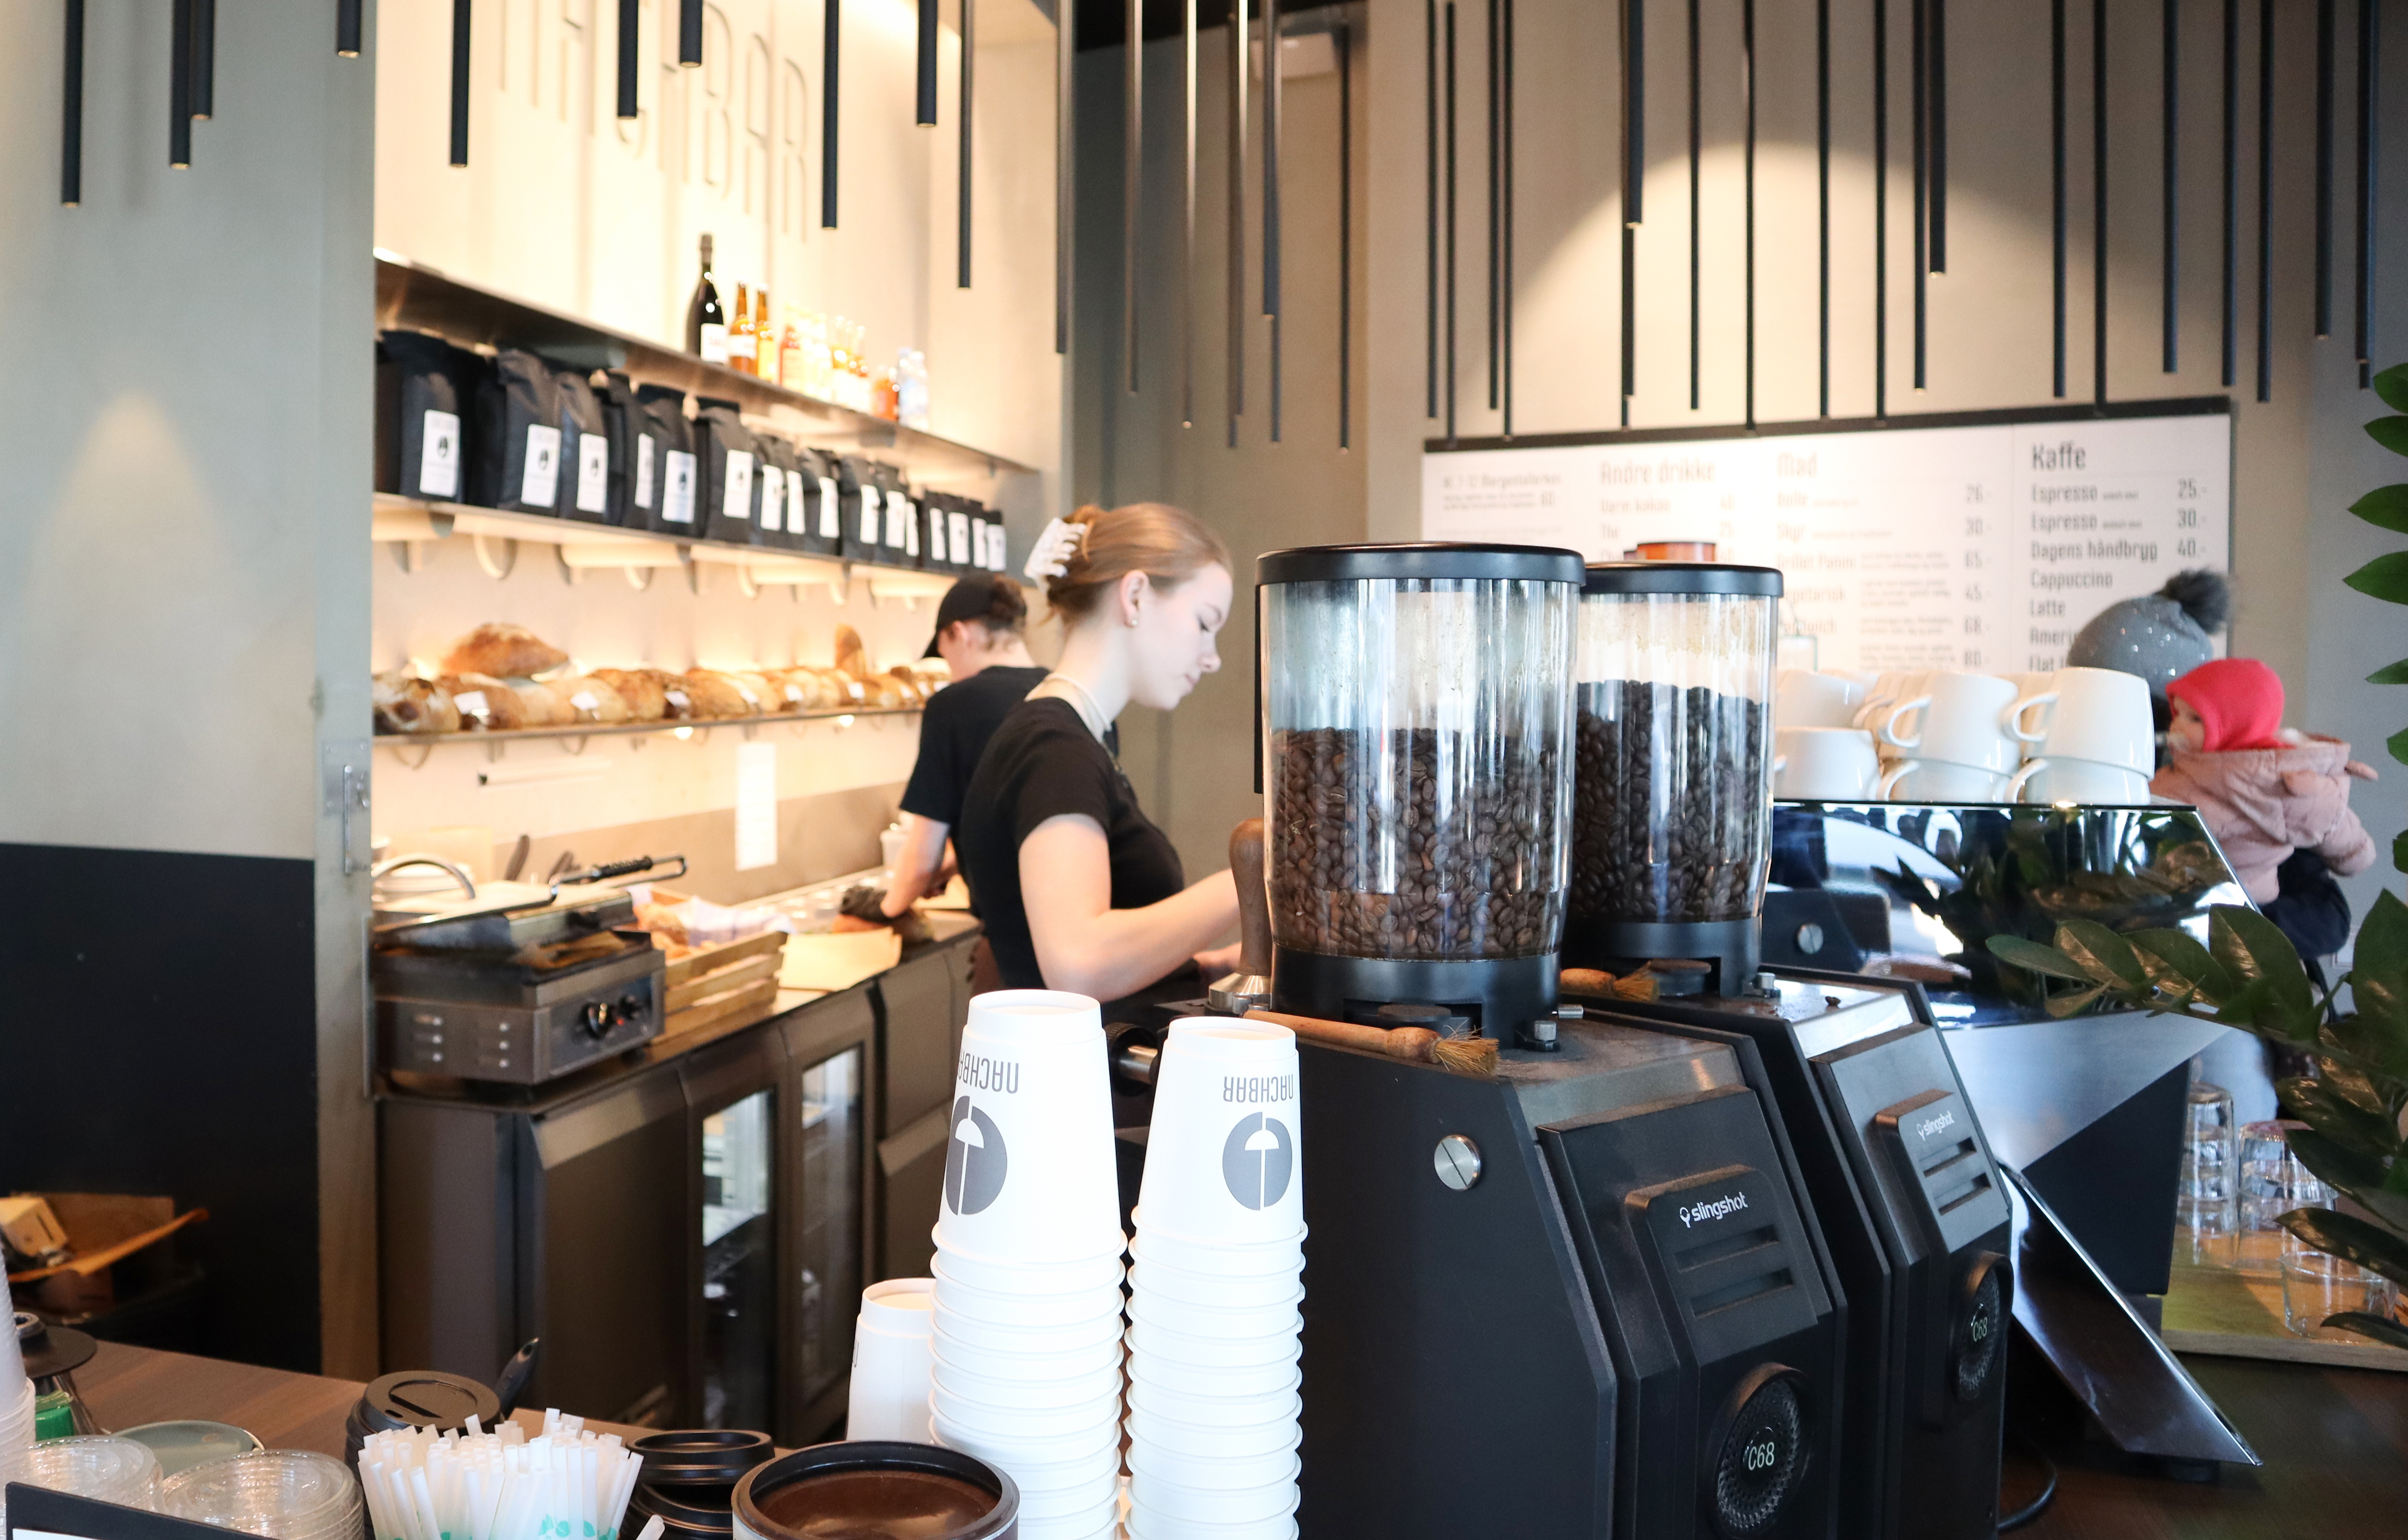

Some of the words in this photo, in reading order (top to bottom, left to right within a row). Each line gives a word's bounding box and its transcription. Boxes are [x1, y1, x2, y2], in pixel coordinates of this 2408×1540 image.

[1778, 452, 1817, 478] Mad
[2032, 441, 2086, 470] Kaffe
[1600, 460, 1651, 486] Andre
[1659, 458, 1715, 483] drikke
[1777, 491, 1808, 508] Bolle
[2032, 485, 2098, 505] Espresso
[1777, 523, 1806, 543] Skyr
[2032, 513, 2097, 535] Espresso
[1777, 553, 1814, 571] Grillet
[1818, 553, 1857, 571] Panini
[2031, 541, 2083, 564] Dagens
[2087, 539, 2158, 564] håndbryg
[2031, 570, 2113, 592] Cappuccino
[1785, 585, 1846, 606] egetarisk
[2030, 600, 2066, 618] Latte
[1783, 617, 1836, 635] andwich
[2029, 656, 2056, 673] Flat
[1224, 1073, 1293, 1102] NACHBAR
[1923, 1110, 1954, 1135] slingshot
[1691, 1191, 1748, 1220] slingshot
[1973, 1317, 1988, 1342] C68
[1748, 1442, 1775, 1470] C68
